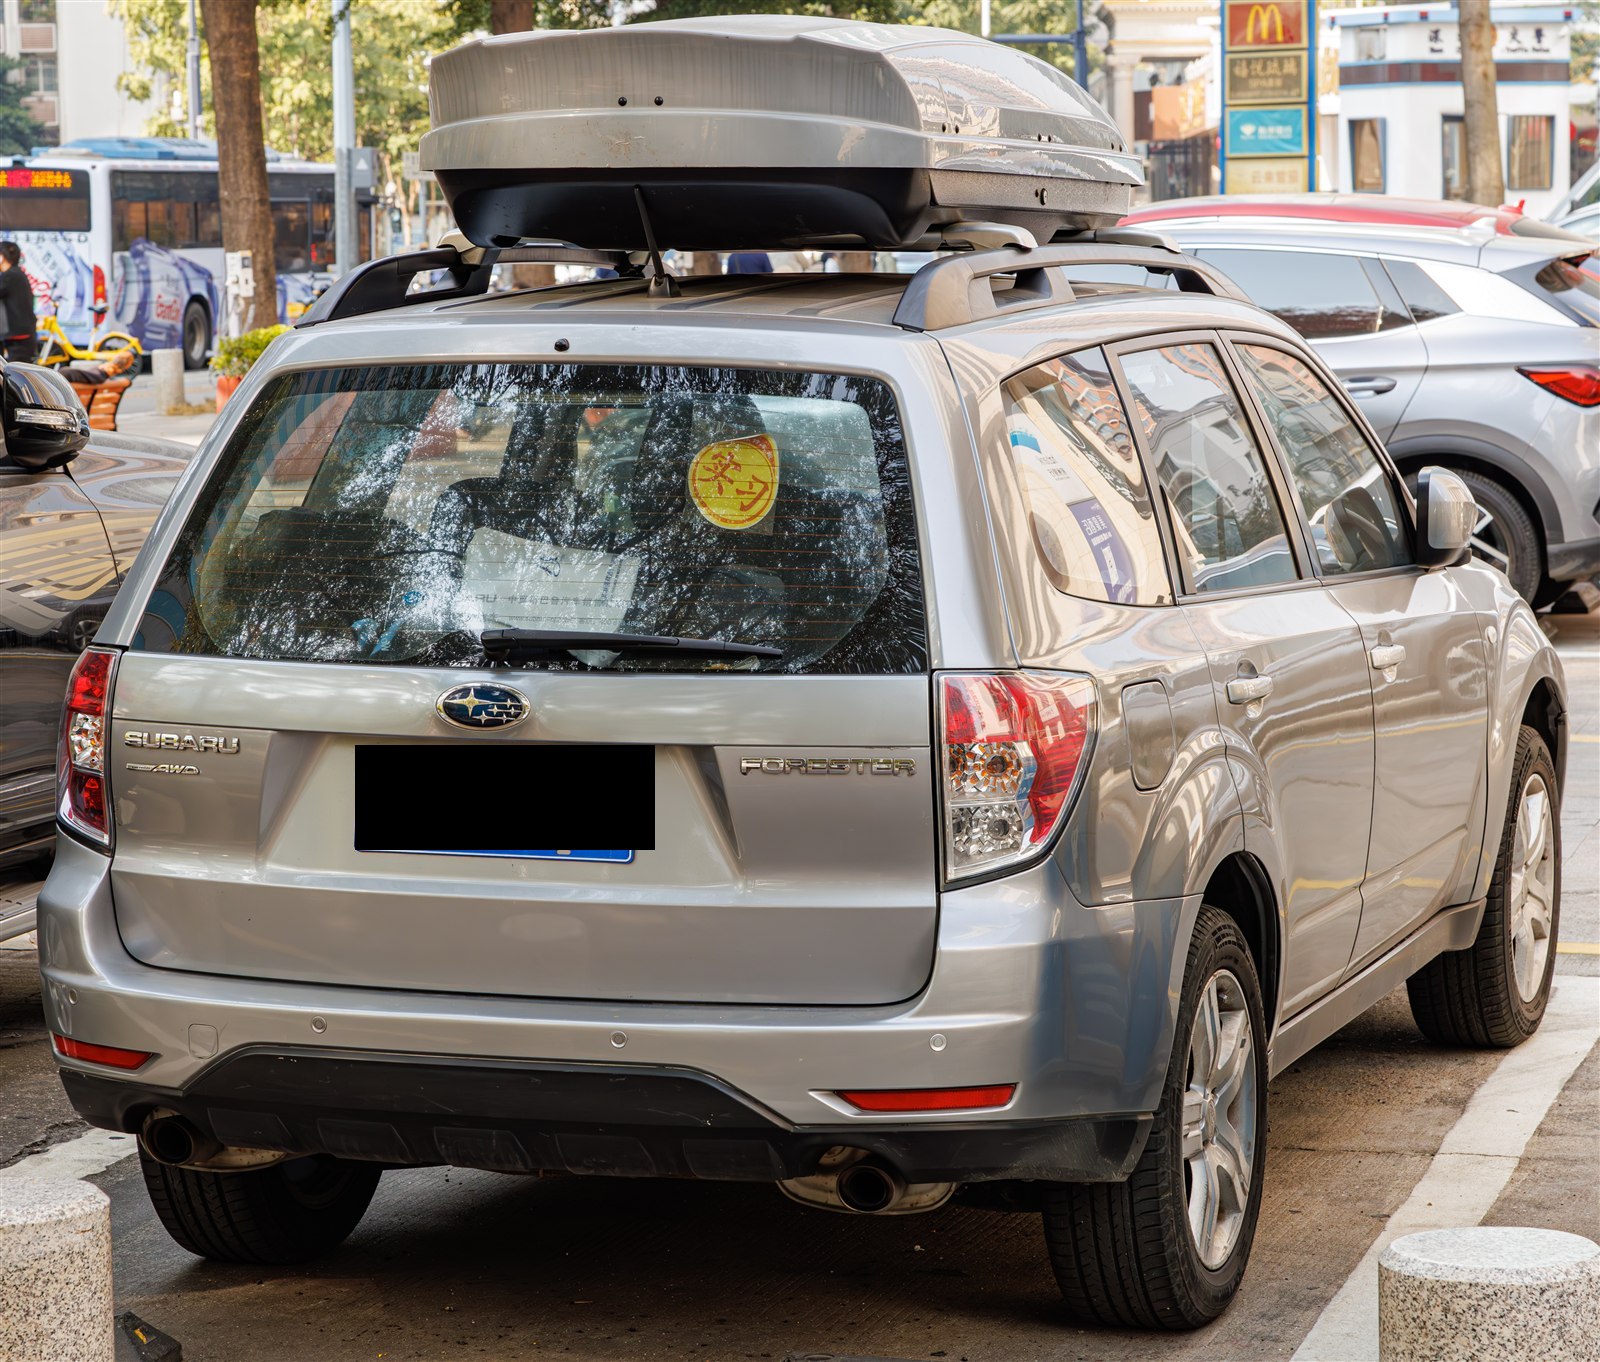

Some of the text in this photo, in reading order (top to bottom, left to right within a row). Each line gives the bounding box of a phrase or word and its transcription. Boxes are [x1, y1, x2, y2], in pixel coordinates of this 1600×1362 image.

[698, 451, 770, 512] 实习
[124, 730, 240, 754] SUBARU
[152, 764, 200, 775] AWD
[740, 756, 917, 776] FORESTER
